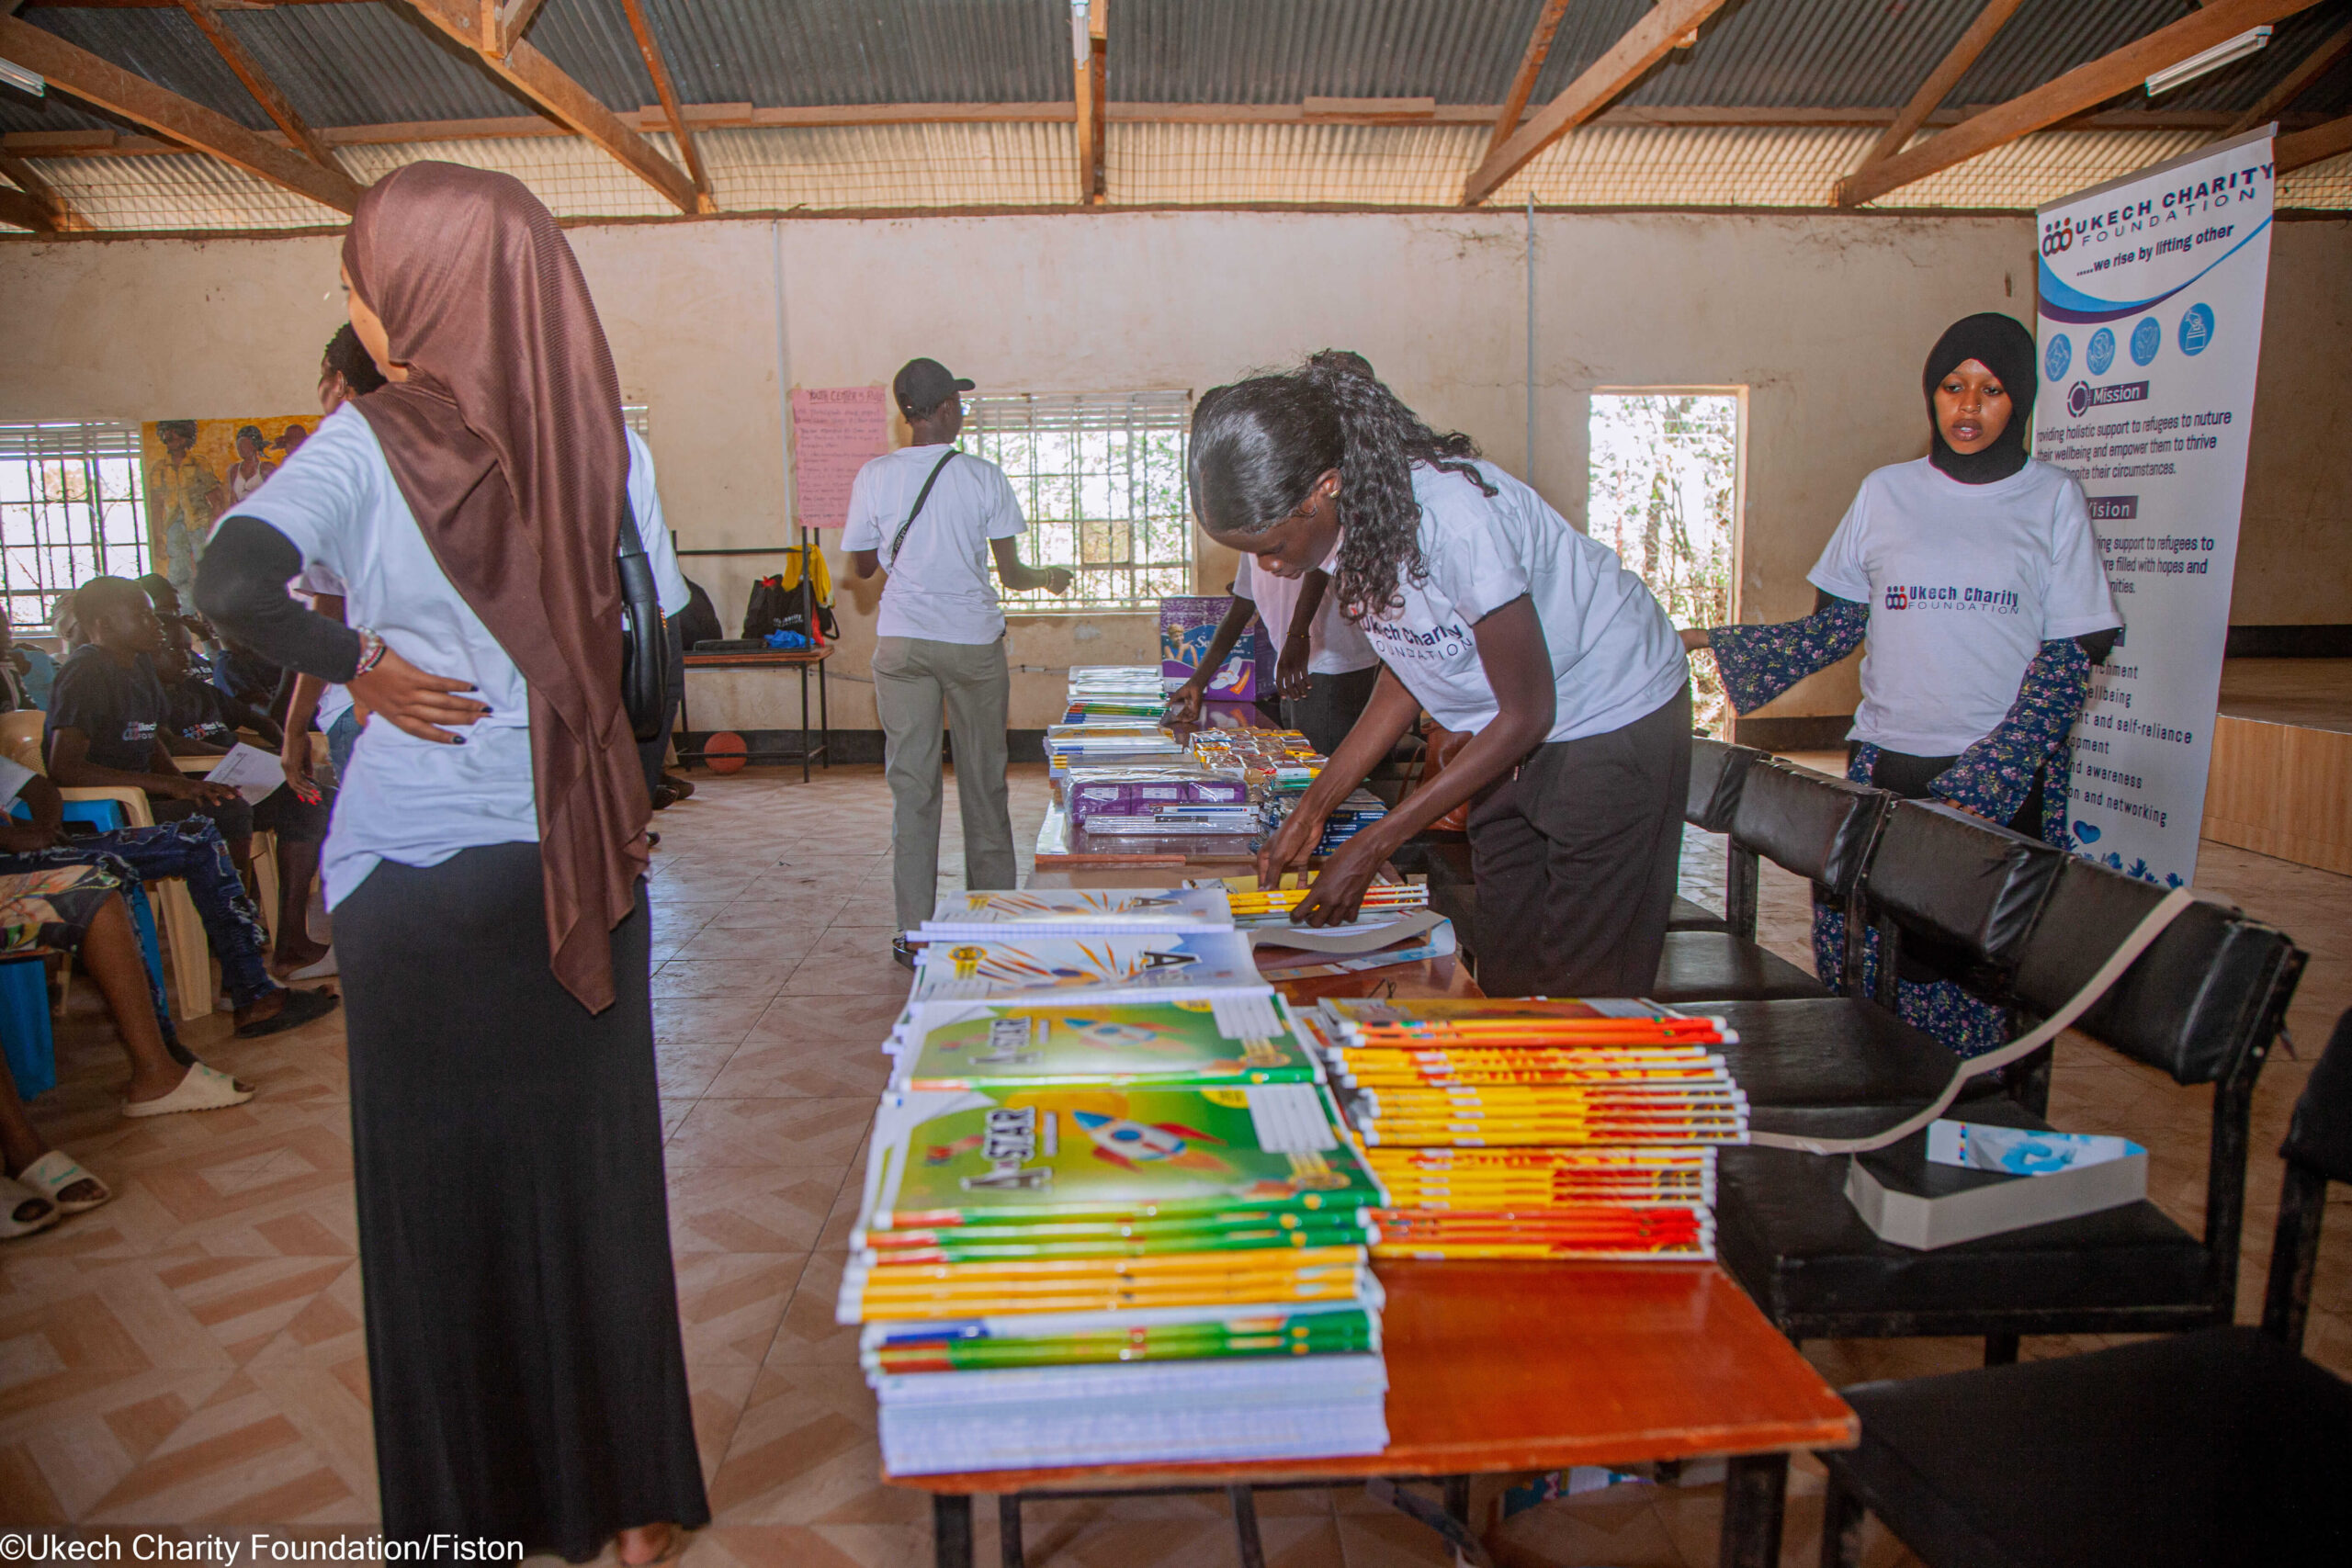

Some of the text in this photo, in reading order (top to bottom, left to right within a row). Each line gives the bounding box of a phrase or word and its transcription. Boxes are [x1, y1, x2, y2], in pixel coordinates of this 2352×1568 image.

[2075, 162, 2274, 235] UKECH CHARITY
[2081, 187, 2256, 247] FOUNDATION
[2113, 252, 2135, 267] rise
[2138, 246, 2153, 263] by
[2155, 234, 2193, 255] lifting
[2195, 224, 2234, 244] other
[2093, 385, 2141, 405] Mission
[2036, 411, 2232, 444] roviding holistic support to refugees to nuture
[2054, 445, 2092, 462] wellbeing
[2093, 443, 2108, 458] and
[2109, 441, 2148, 459] empower
[2150, 438, 2171, 454] them
[2174, 437, 2184, 452] to
[2186, 434, 2218, 450] thrive
[2092, 464, 2111, 479] their
[2112, 462, 2177, 479] circumstances.
[2113, 536, 2145, 553] support
[2146, 536, 2155, 550] to
[2157, 535, 2199, 554] refugees
[2200, 536, 2214, 551] to
[2116, 556, 2137, 571] filled
[2138, 557, 2156, 572] with
[2157, 557, 2185, 577] hopes
[2187, 558, 2208, 574] and
[1908, 601, 2020, 615] FOUNDATION
[1910, 586, 2019, 607] Ukech Charity
[1376, 637, 1473, 660] OUNDATION
[2086, 684, 2132, 708] ellbeing
[2094, 715, 2112, 728] and
[2116, 717, 2193, 745] self-reliance
[2068, 736, 2109, 755] opment
[2086, 764, 2143, 789] awareness
[2085, 791, 2102, 806] and
[2107, 796, 2167, 828] networking
